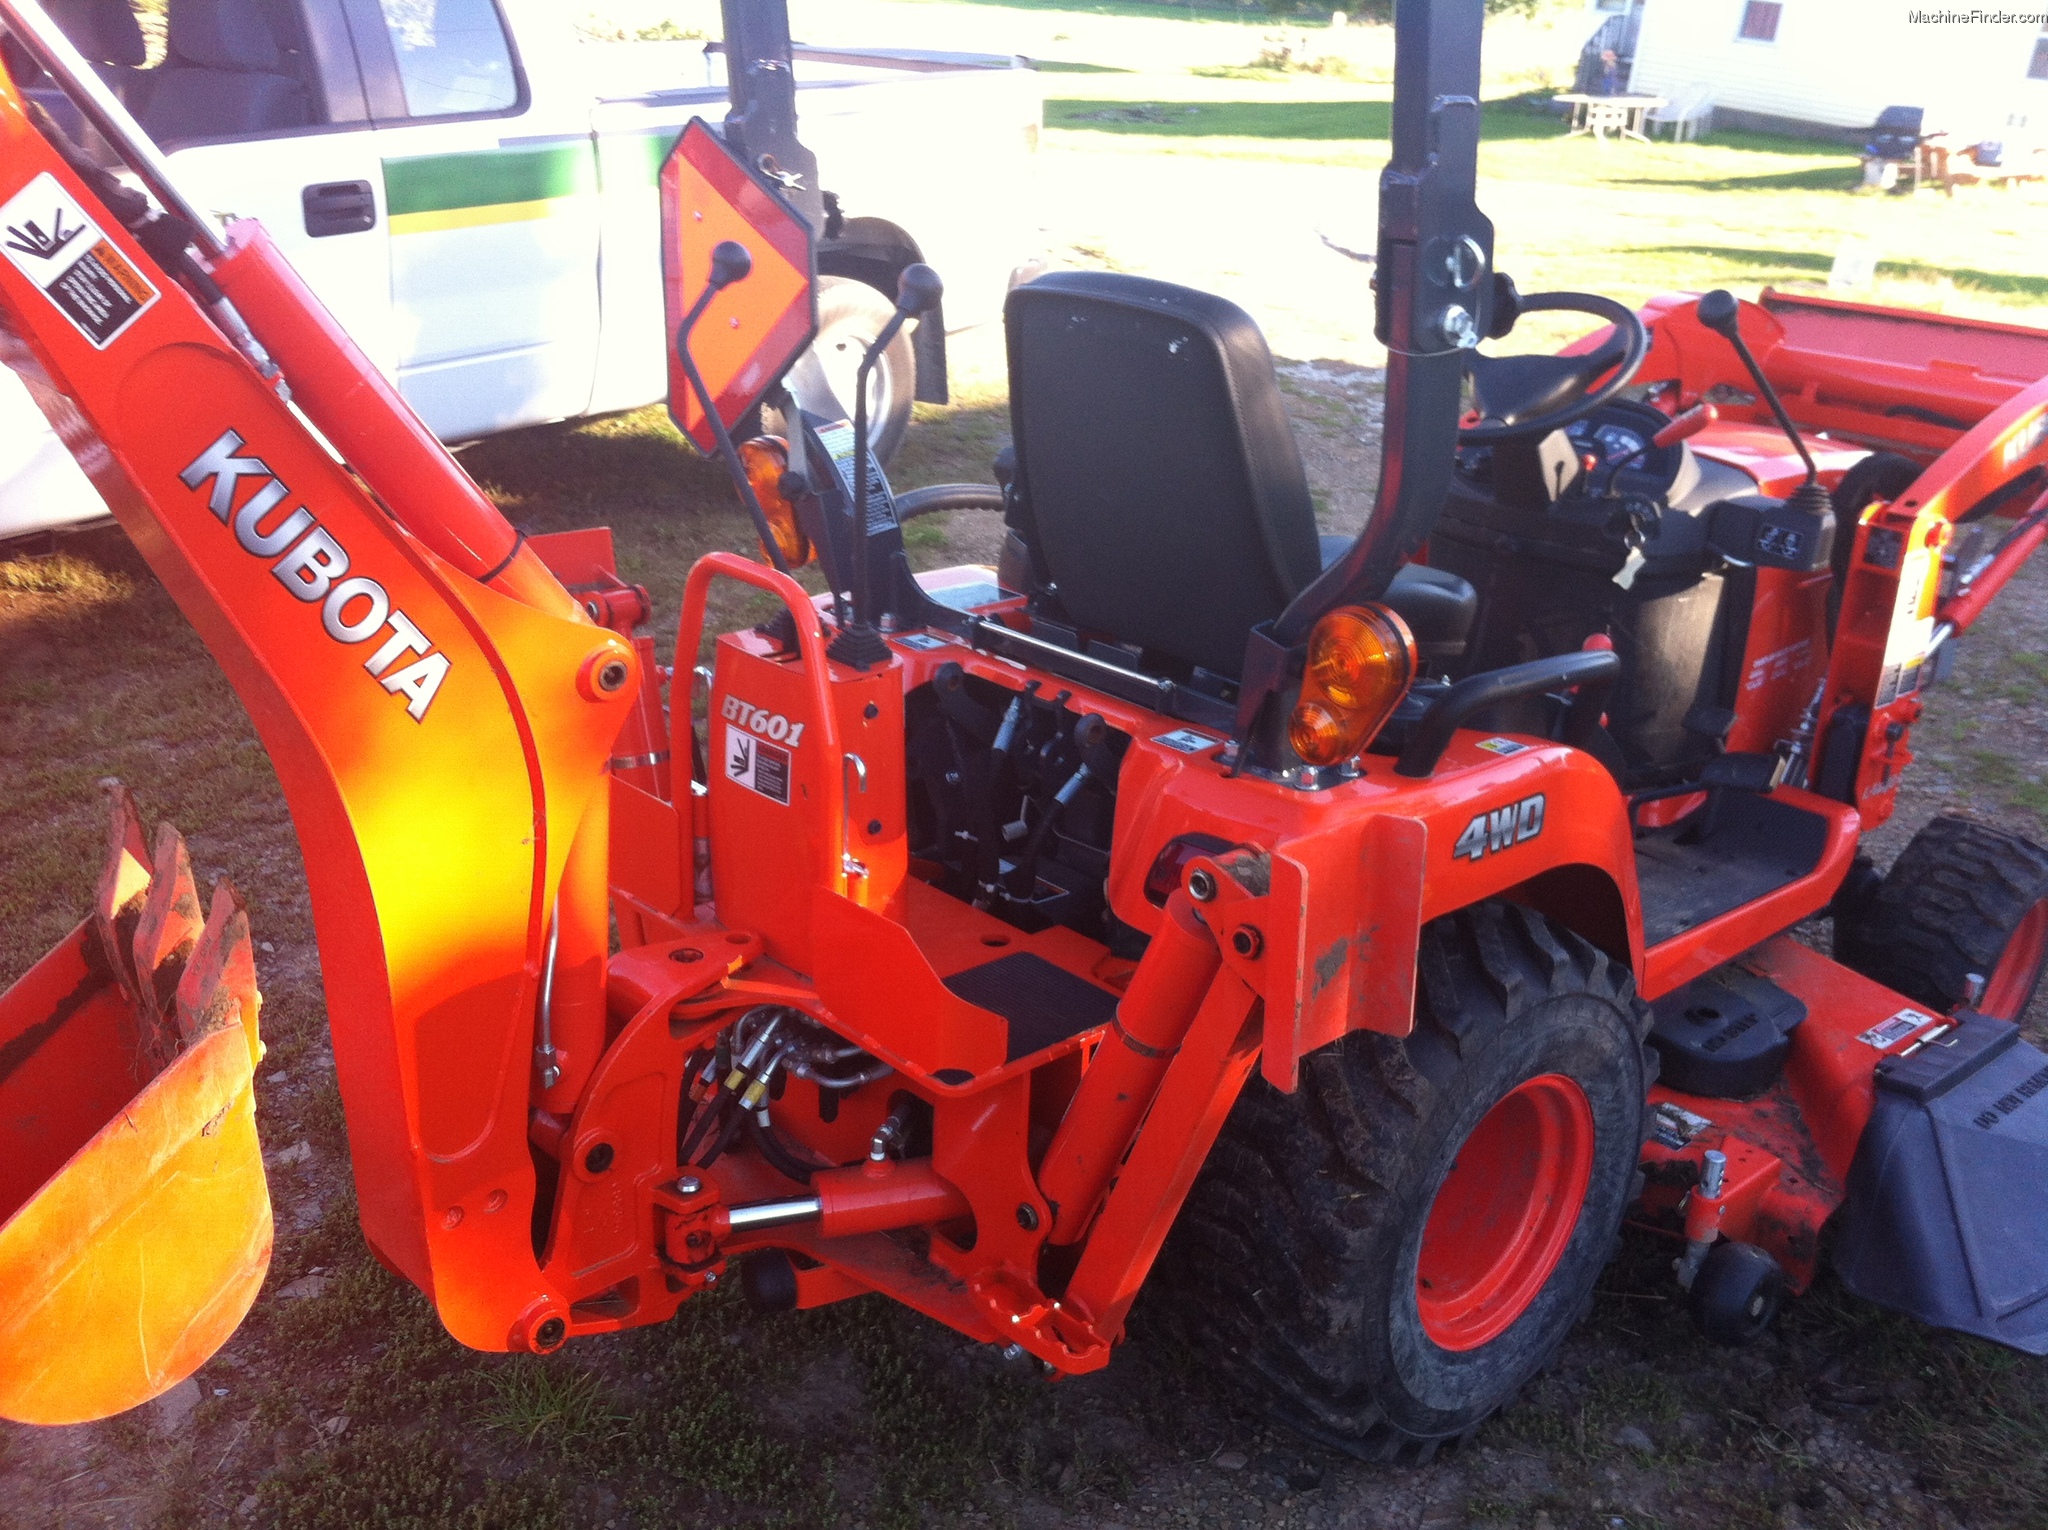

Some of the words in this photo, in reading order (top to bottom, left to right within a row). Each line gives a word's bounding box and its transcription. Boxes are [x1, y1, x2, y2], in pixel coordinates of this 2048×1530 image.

[178, 426, 452, 724] KUBOTA
[721, 693, 805, 748] BT601
[1452, 791, 1546, 861] 4WD
